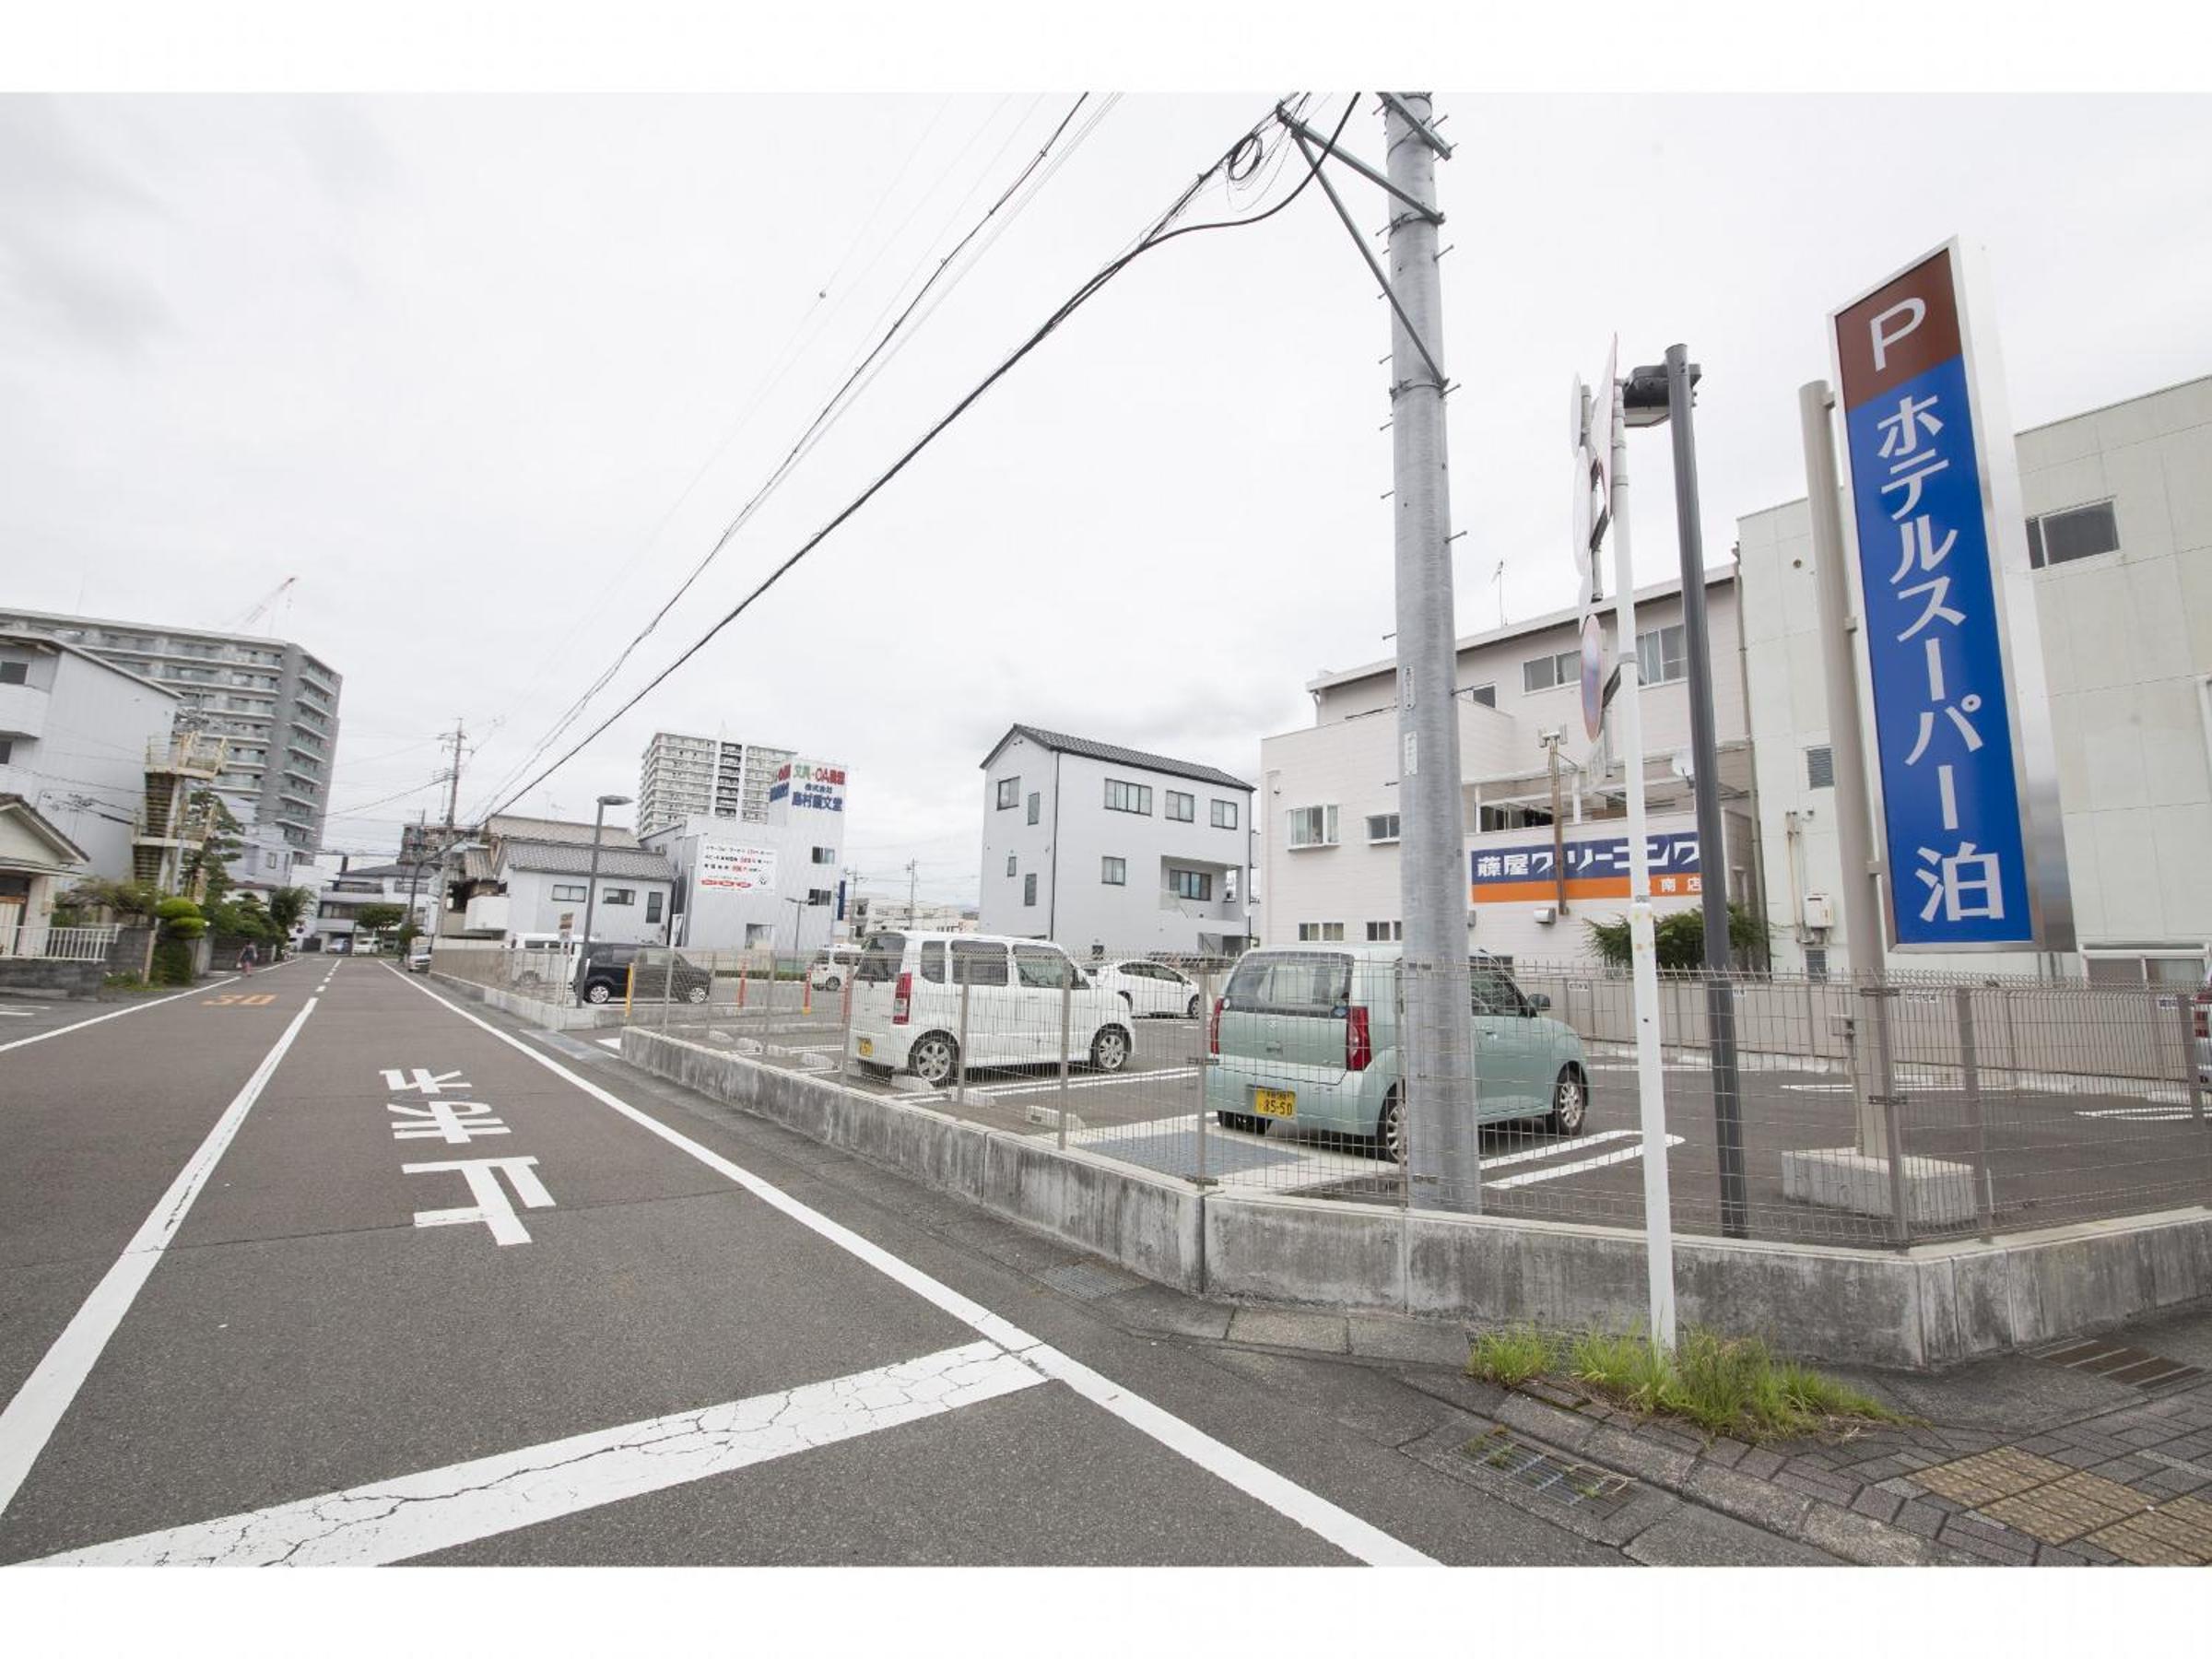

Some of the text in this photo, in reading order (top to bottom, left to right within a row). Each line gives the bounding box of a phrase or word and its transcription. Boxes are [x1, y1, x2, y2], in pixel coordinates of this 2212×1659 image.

[1869, 297, 1926, 371] P
[1877, 394, 2006, 923] ホテルスーパー泊
